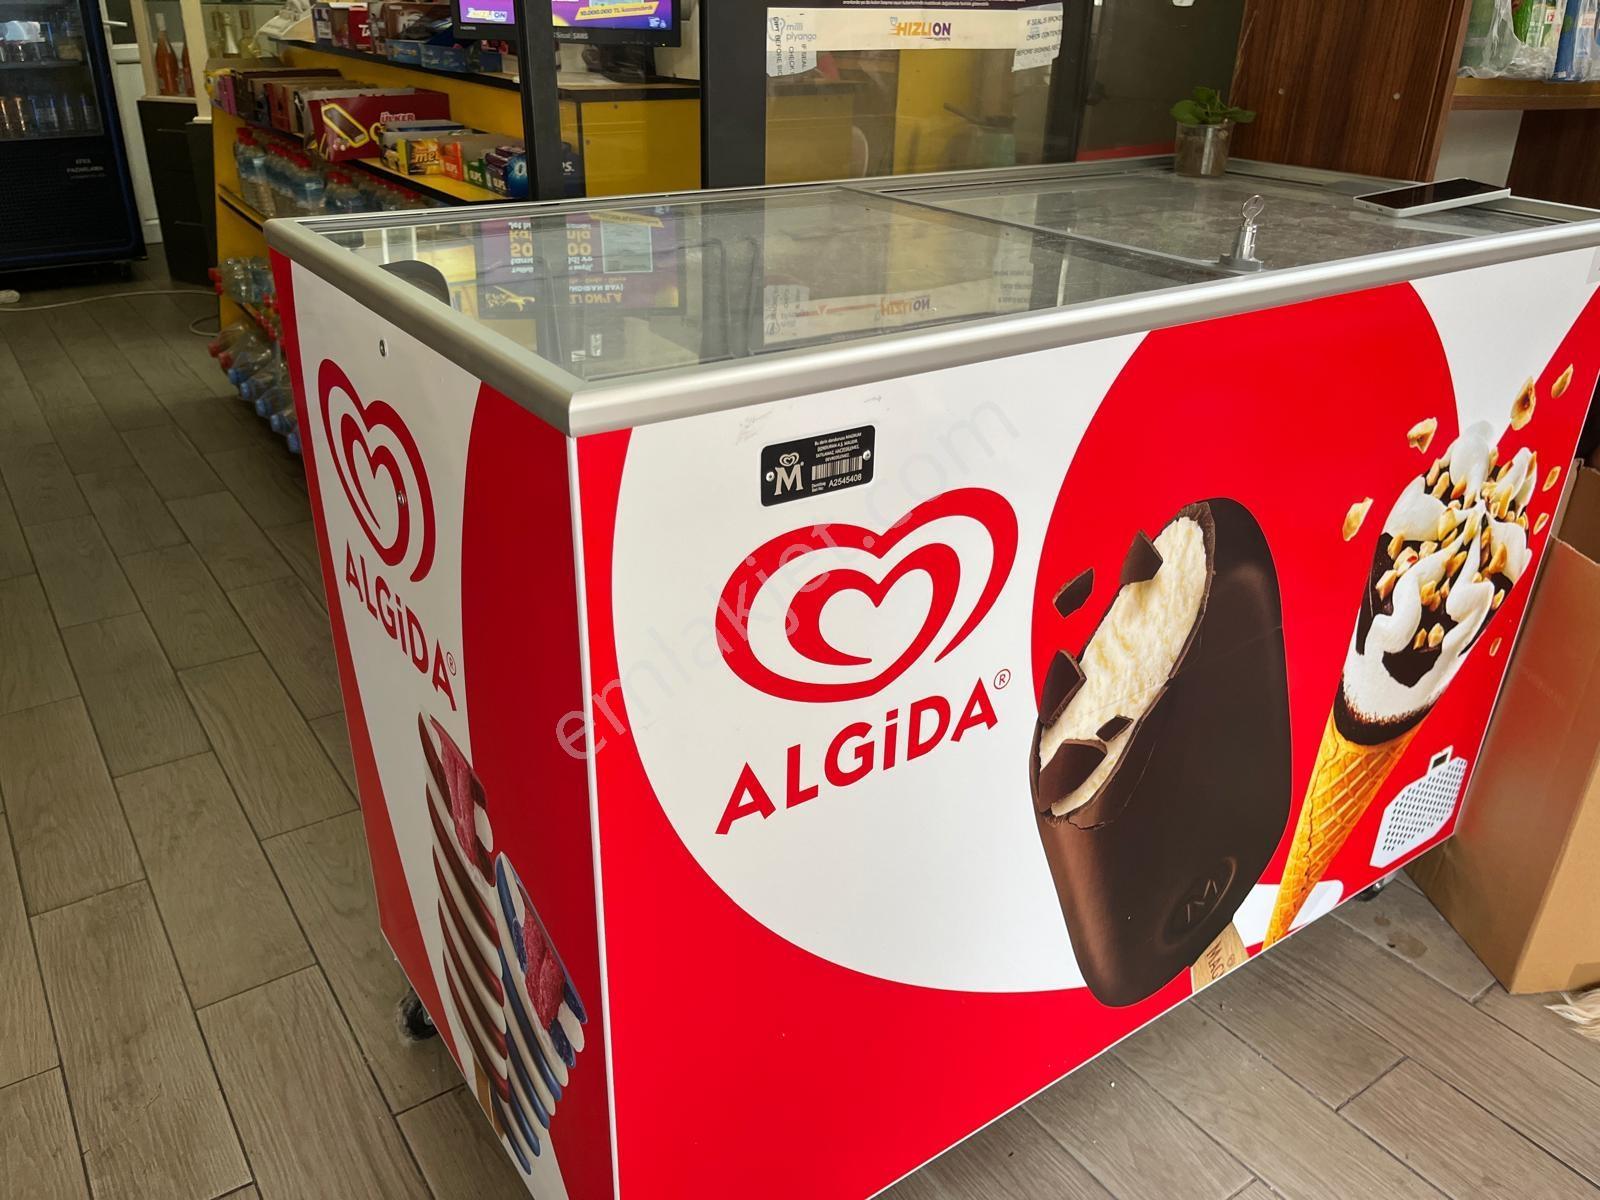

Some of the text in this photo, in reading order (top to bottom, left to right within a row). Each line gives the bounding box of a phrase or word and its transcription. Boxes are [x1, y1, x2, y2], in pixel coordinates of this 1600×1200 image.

[786, 23, 803, 31] milli
[786, 33, 816, 42] piyango
[774, 463, 804, 496] M
[828, 473, 863, 488] A2545408
